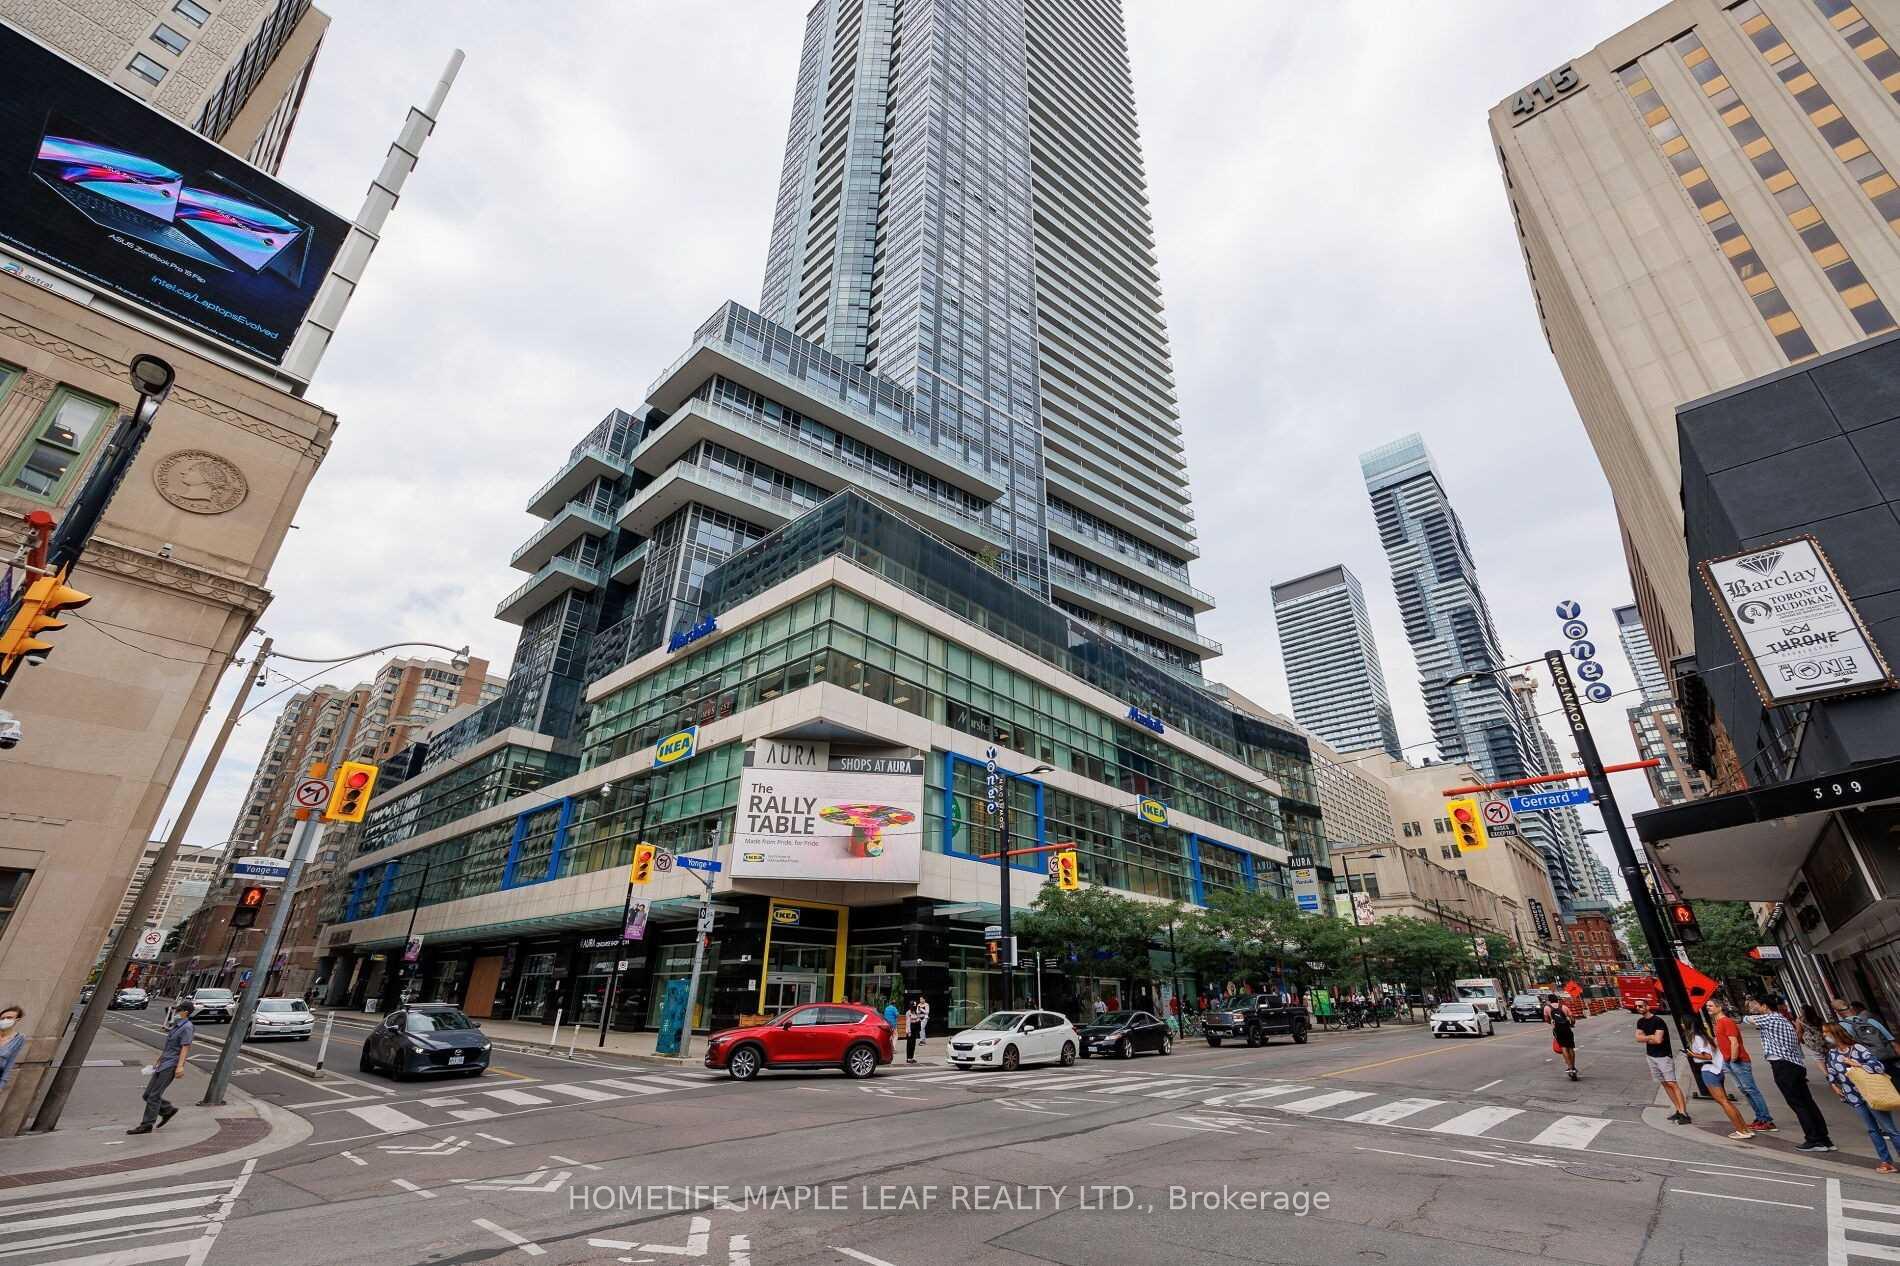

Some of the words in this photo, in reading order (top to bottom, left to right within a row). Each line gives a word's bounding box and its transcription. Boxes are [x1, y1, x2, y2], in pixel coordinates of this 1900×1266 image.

[1511, 63, 1579, 116] 415
[107, 234, 135, 250] ASUS
[24, 273, 54, 289] astral
[1724, 567, 1817, 601] Barclay
[1769, 585, 1828, 604] TORONTO
[1774, 593, 1834, 613] BUDOKAN
[1766, 631, 1840, 654] THRONE
[1550, 656, 1585, 731] DOWNTOWN
[658, 737, 690, 758] IKEA
[767, 744, 816, 766] AURA
[841, 758, 872, 772] SHOPS
[873, 760, 886, 772] AT
[886, 760, 912, 774] AURA
[751, 783, 774, 795] The
[748, 795, 818, 816] RALLY
[1521, 791, 1570, 808] Gerrard
[1142, 803, 1166, 819] IKEA
[747, 814, 816, 835] TABLE
[246, 865, 271, 875] Yonge
[1291, 857, 1312, 867] AURA
[775, 911, 797, 919] IKEA
